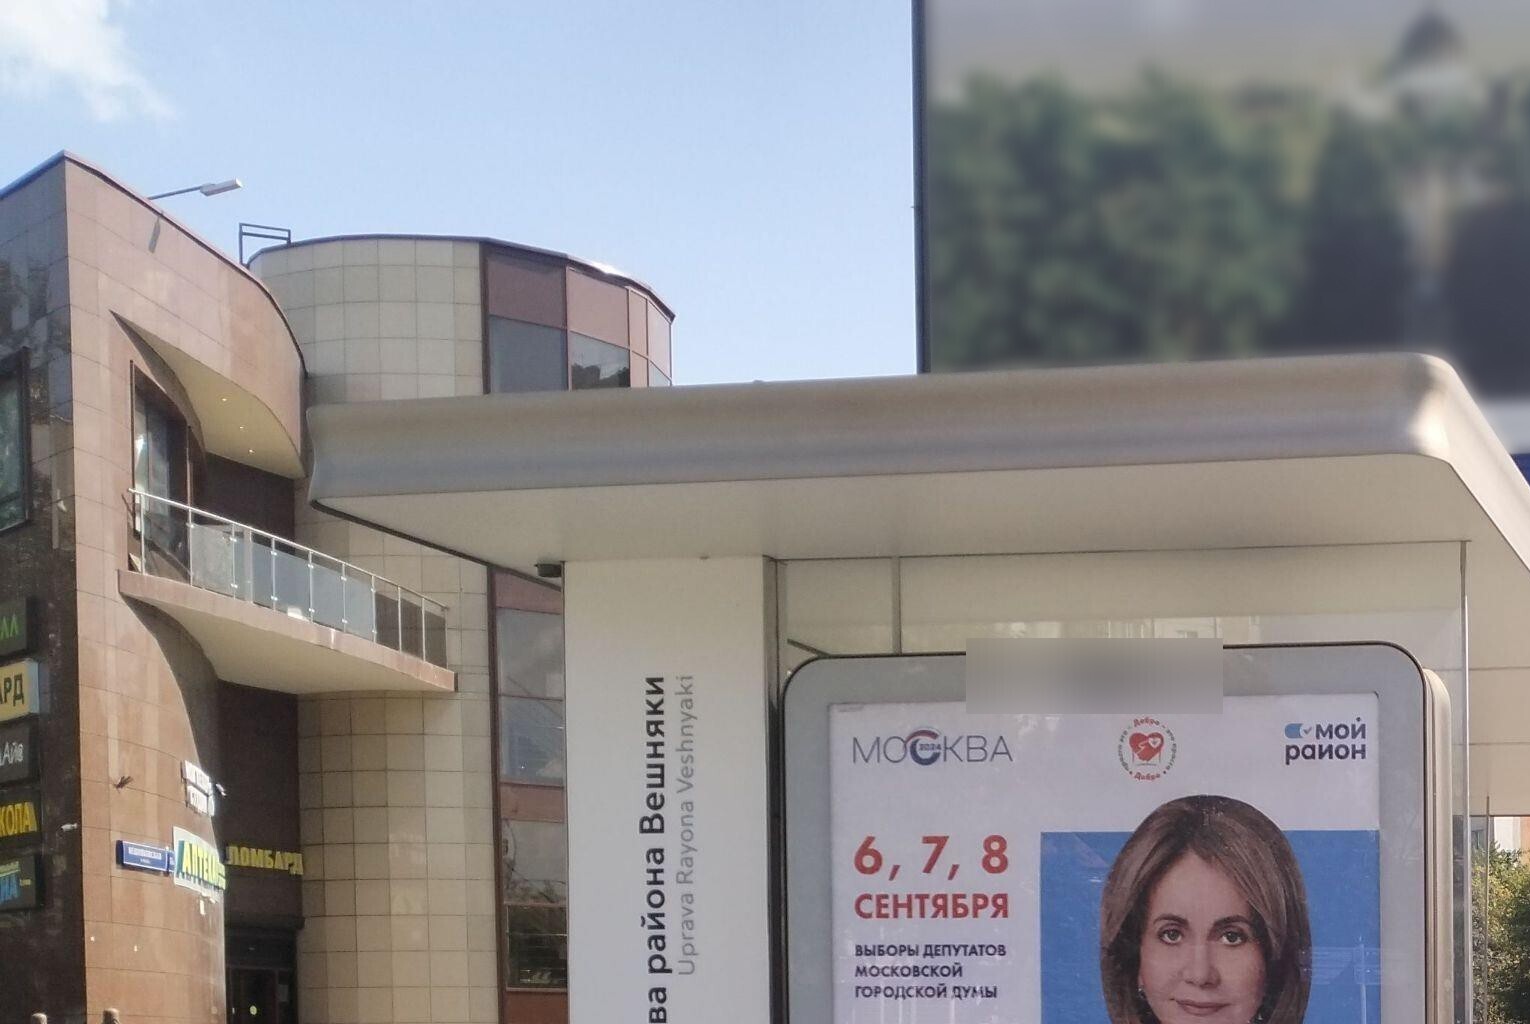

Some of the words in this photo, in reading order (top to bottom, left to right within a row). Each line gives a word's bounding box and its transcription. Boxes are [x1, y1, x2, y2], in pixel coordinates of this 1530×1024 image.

[639, 676, 666, 835] Вешняки
[676, 674, 698, 795] Veshnyaki
[852, 726, 1014, 766] МОСКВА
[226, 846, 304, 876] ЛОМБАРД
[676, 801, 698, 885] Rayona
[854, 835, 901, 882] 6,
[922, 835, 960, 881] 7,
[981, 834, 1009, 874] 8
[640, 846, 673, 975] района
[854, 893, 1009, 920] СЕНТЯБРЯ
[678, 891, 700, 976] Uprava
[855, 944, 919, 957] ВЫБОРЫ
[922, 944, 1007, 959] ДЕПУТАТОВ
[854, 961, 963, 978] МОСКОВСКОЙ
[855, 982, 948, 1001] ГОРОДСКОЙ
[952, 985, 998, 1001] ДУМЫ
